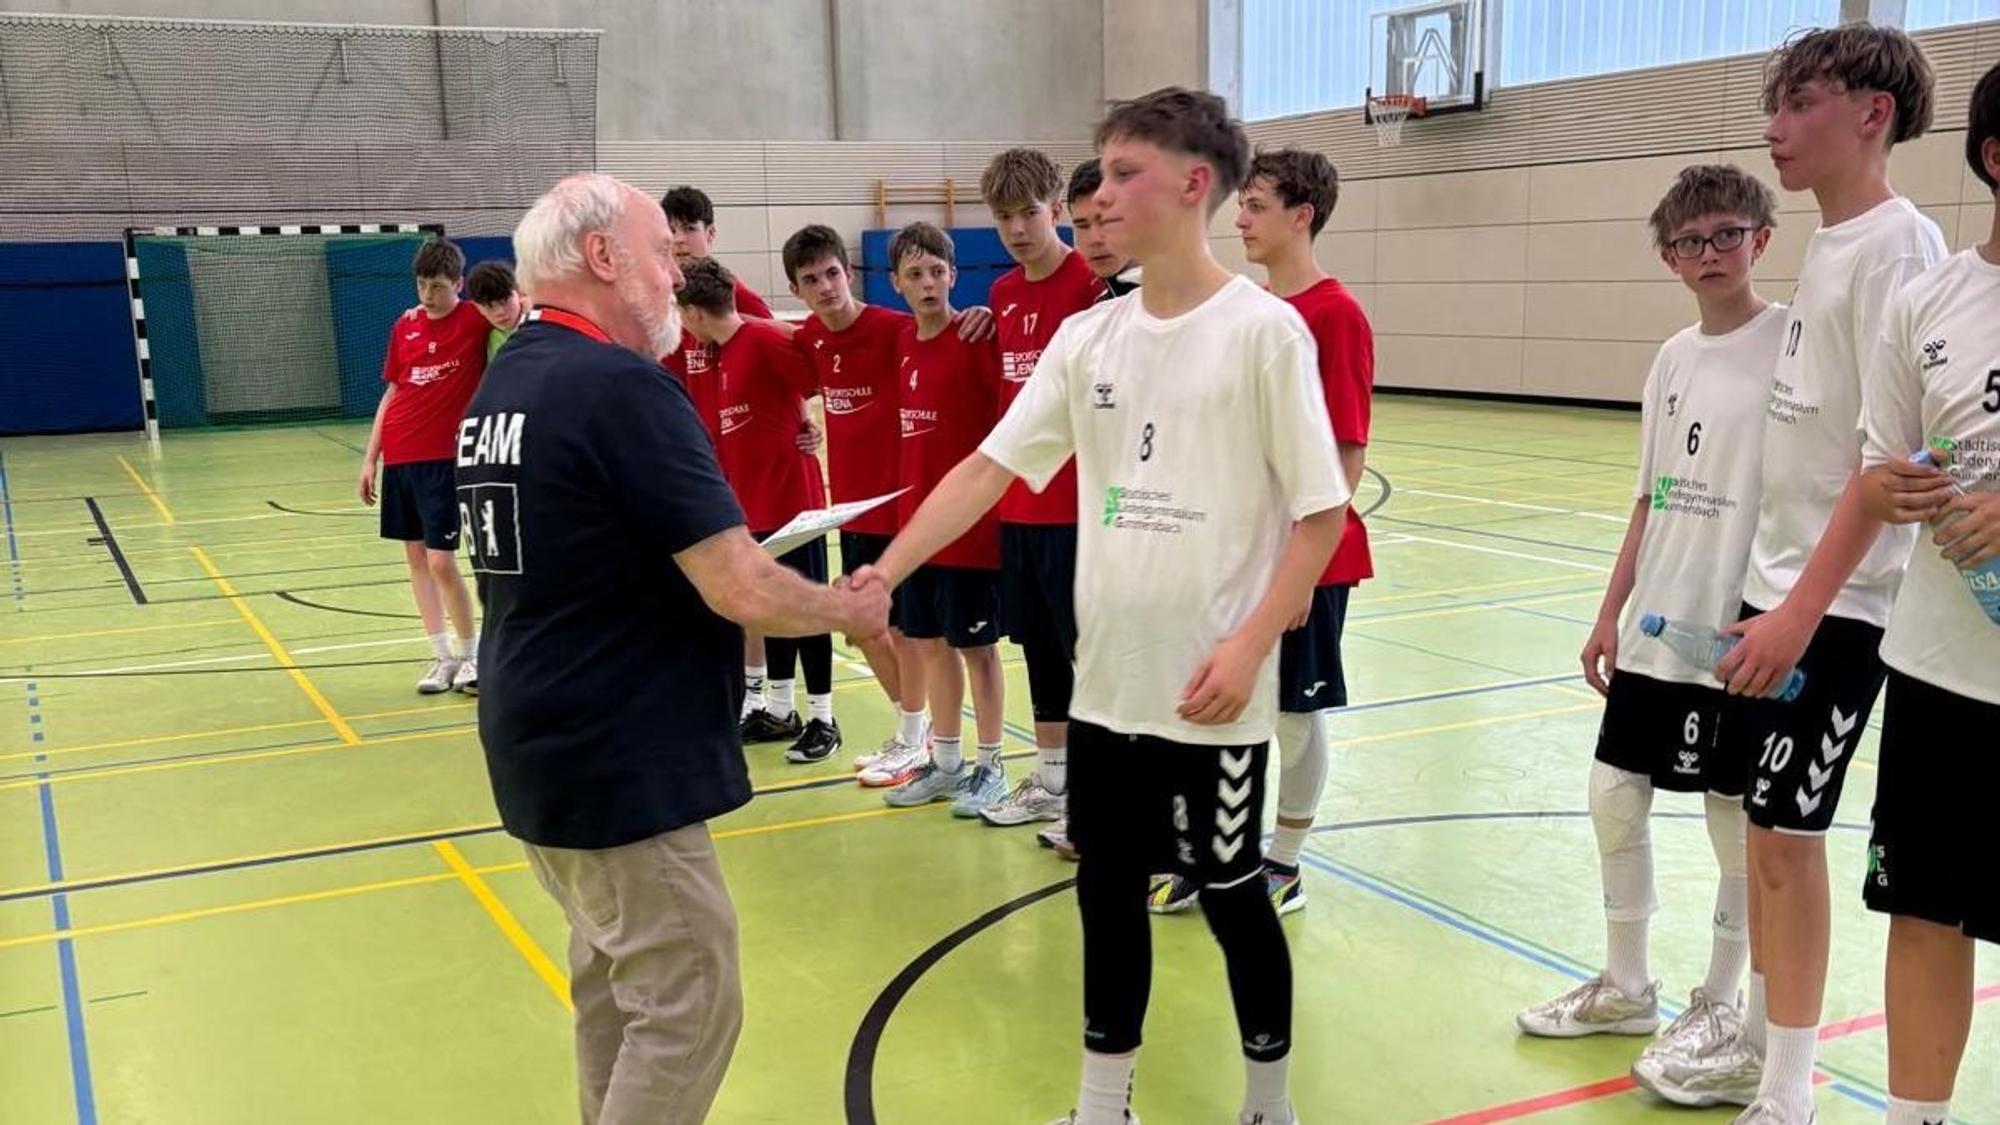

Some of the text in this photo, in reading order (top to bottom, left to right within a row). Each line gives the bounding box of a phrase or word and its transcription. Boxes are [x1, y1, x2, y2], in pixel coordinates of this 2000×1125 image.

[1023, 313, 1038, 335] 17
[833, 354, 841, 373] 2
[909, 369, 918, 391] 4
[1982, 369, 2000, 413] 5
[456, 413, 526, 467] EAM
[1140, 422, 1154, 462] 8
[1687, 421, 1701, 456] 6
[1684, 711, 1699, 745] 6
[1759, 731, 1793, 773] 10
